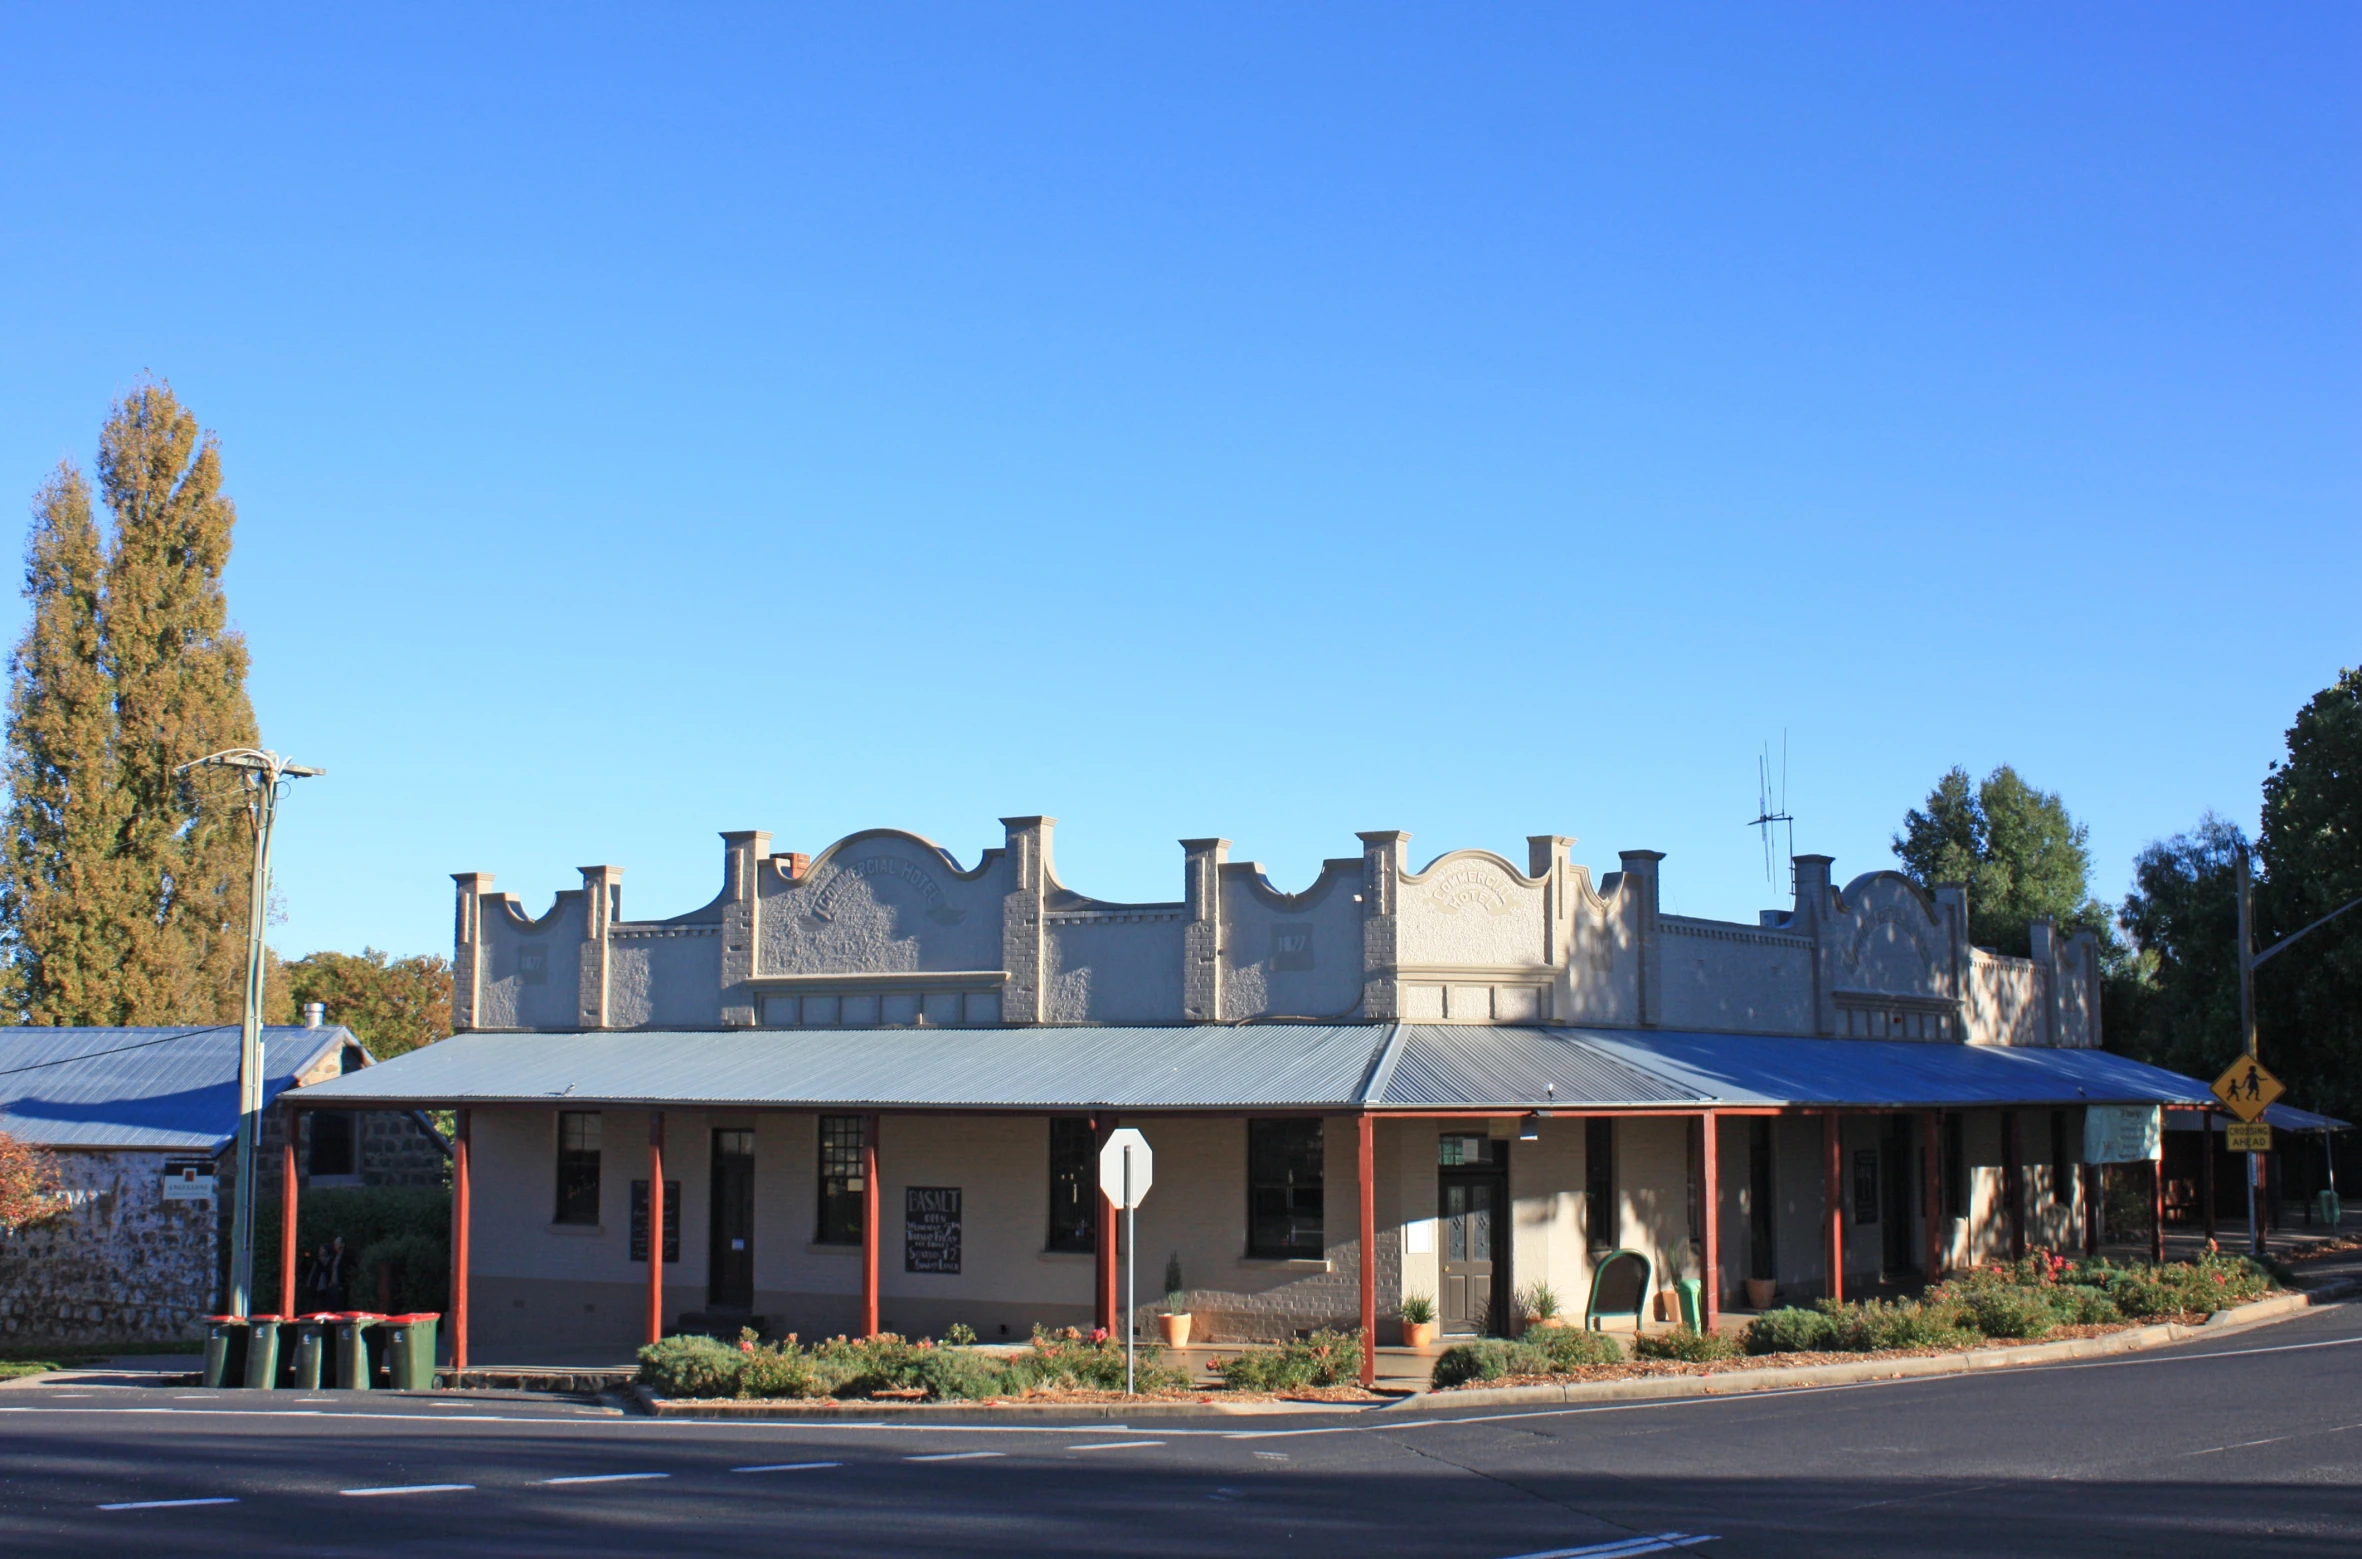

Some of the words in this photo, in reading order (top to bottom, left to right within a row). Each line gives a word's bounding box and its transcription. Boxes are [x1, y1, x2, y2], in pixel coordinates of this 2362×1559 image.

[818, 858, 898, 912] COMMERCIAL
[901, 861, 938, 905] HOTEL
[1432, 871, 1508, 905] COMMERCIAL
[1449, 889, 1492, 911] HOTEL
[2229, 1127, 2267, 1136] CROSSING
[2232, 1138, 2266, 1146] AHEAD
[908, 1190, 960, 1213] BASALT
